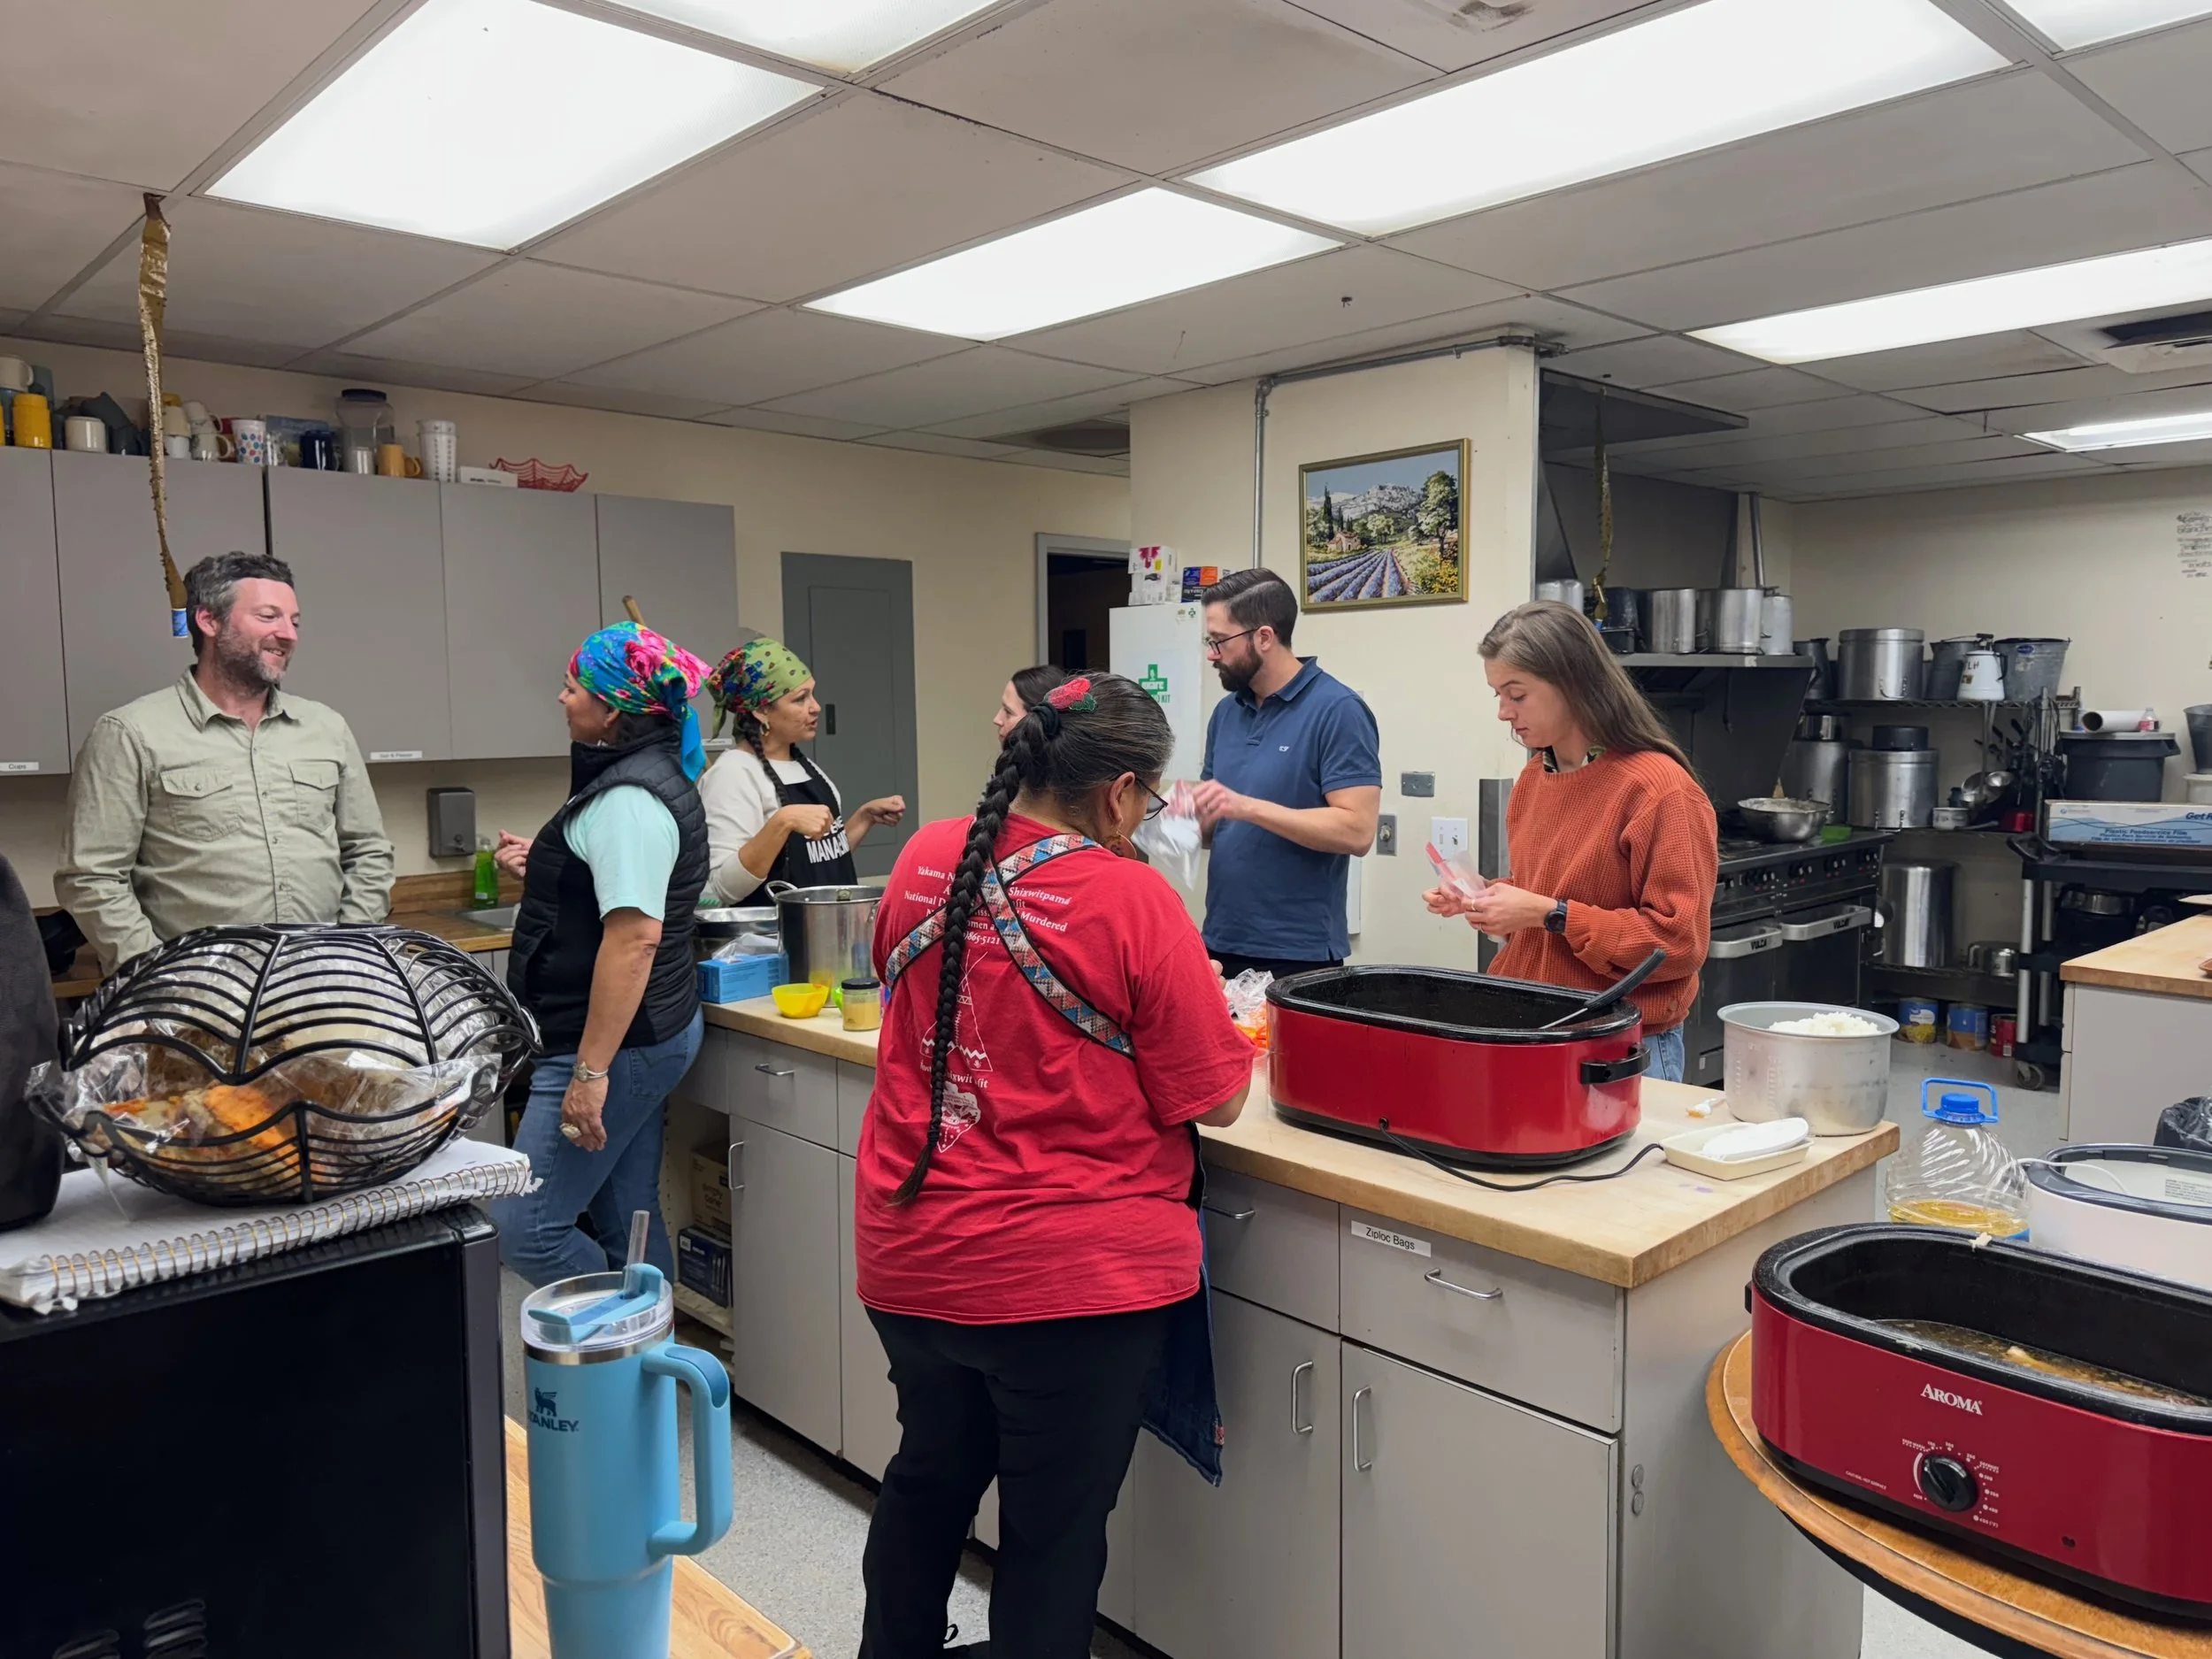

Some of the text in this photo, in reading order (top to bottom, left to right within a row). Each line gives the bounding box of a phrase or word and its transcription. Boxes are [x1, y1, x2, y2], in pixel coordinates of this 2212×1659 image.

[2185, 811, 2206, 820] Get
[918, 866, 946, 880] Yakama
[904, 890, 936, 906] National
[966, 920, 989, 931] omen
[1020, 913, 1068, 933] Murdered
[1365, 1226, 1416, 1250] Ziploc Bags
[1920, 1383, 1983, 1416] AROMA
